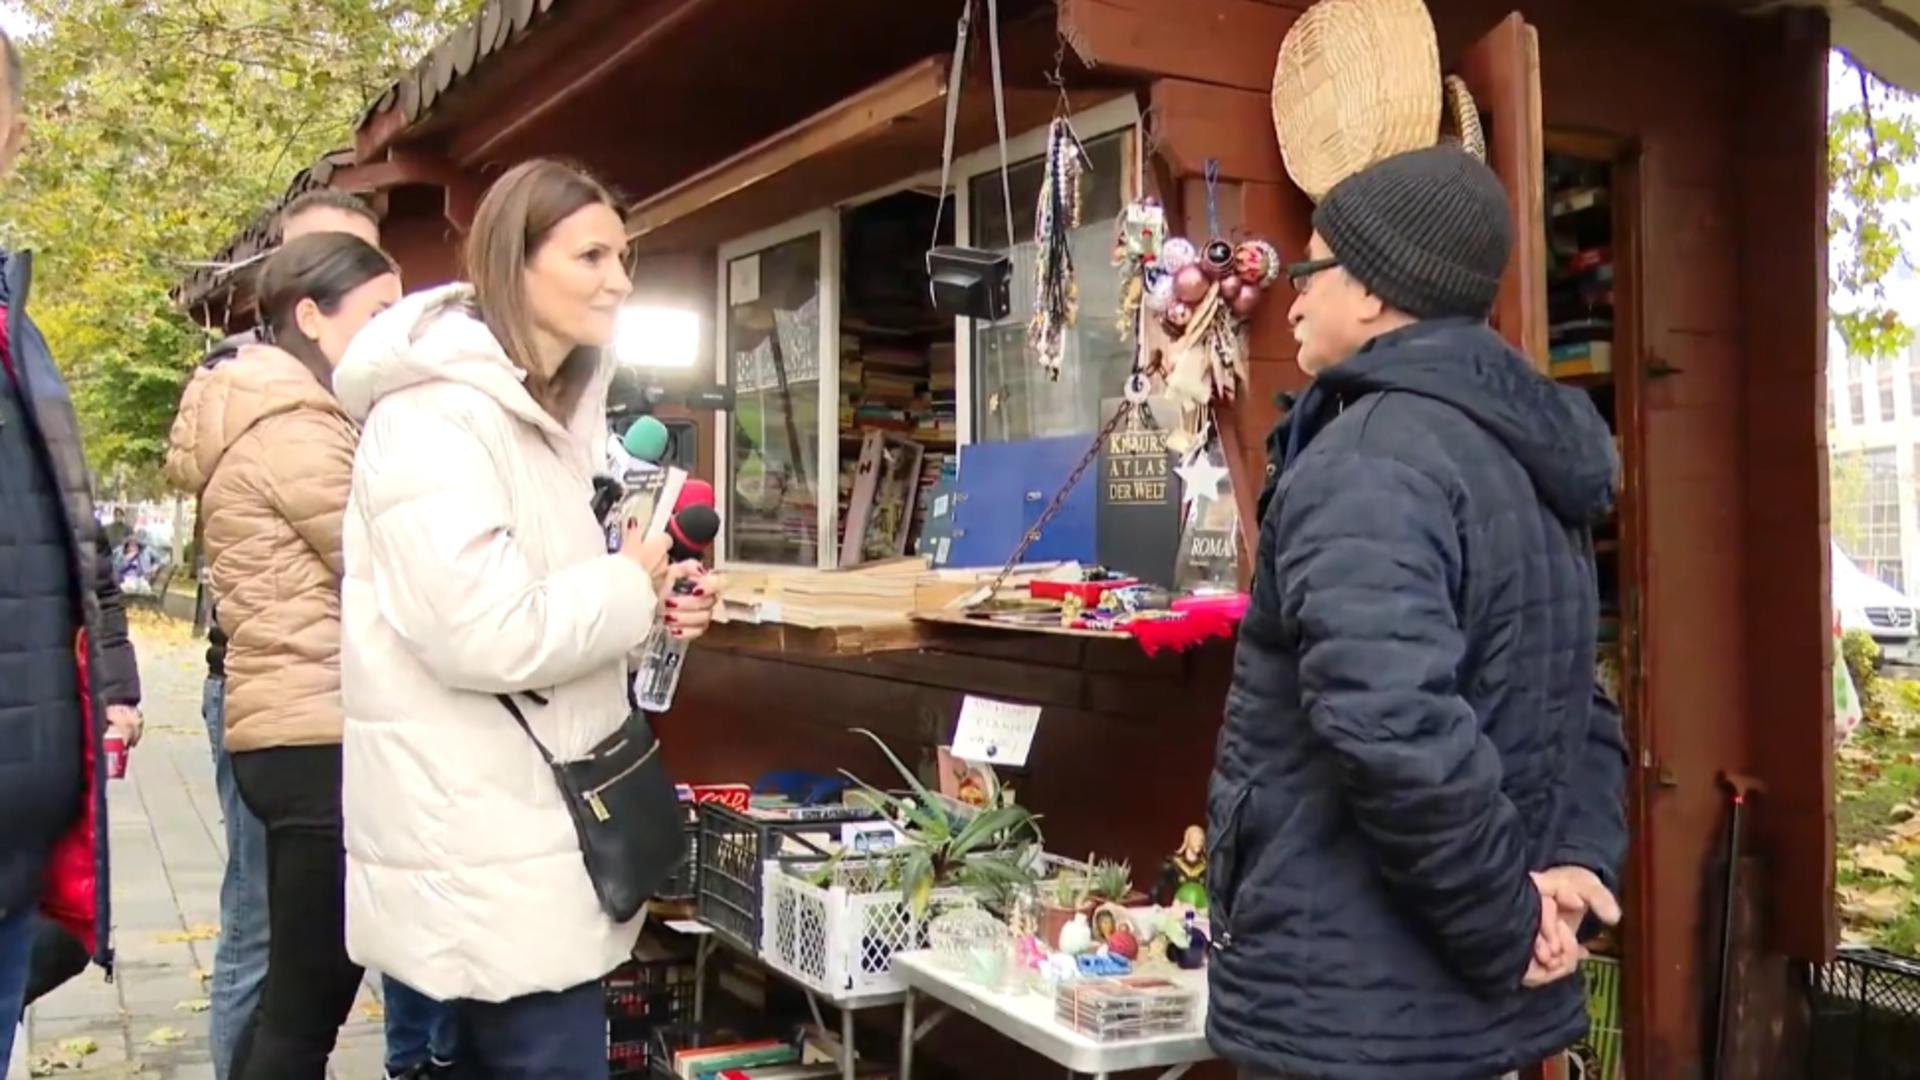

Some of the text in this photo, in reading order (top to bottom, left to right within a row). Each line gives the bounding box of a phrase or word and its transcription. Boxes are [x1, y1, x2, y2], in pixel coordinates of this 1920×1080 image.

[1110, 459, 1167, 477] ATLAS
[1109, 481, 1167, 500] DER WELT
